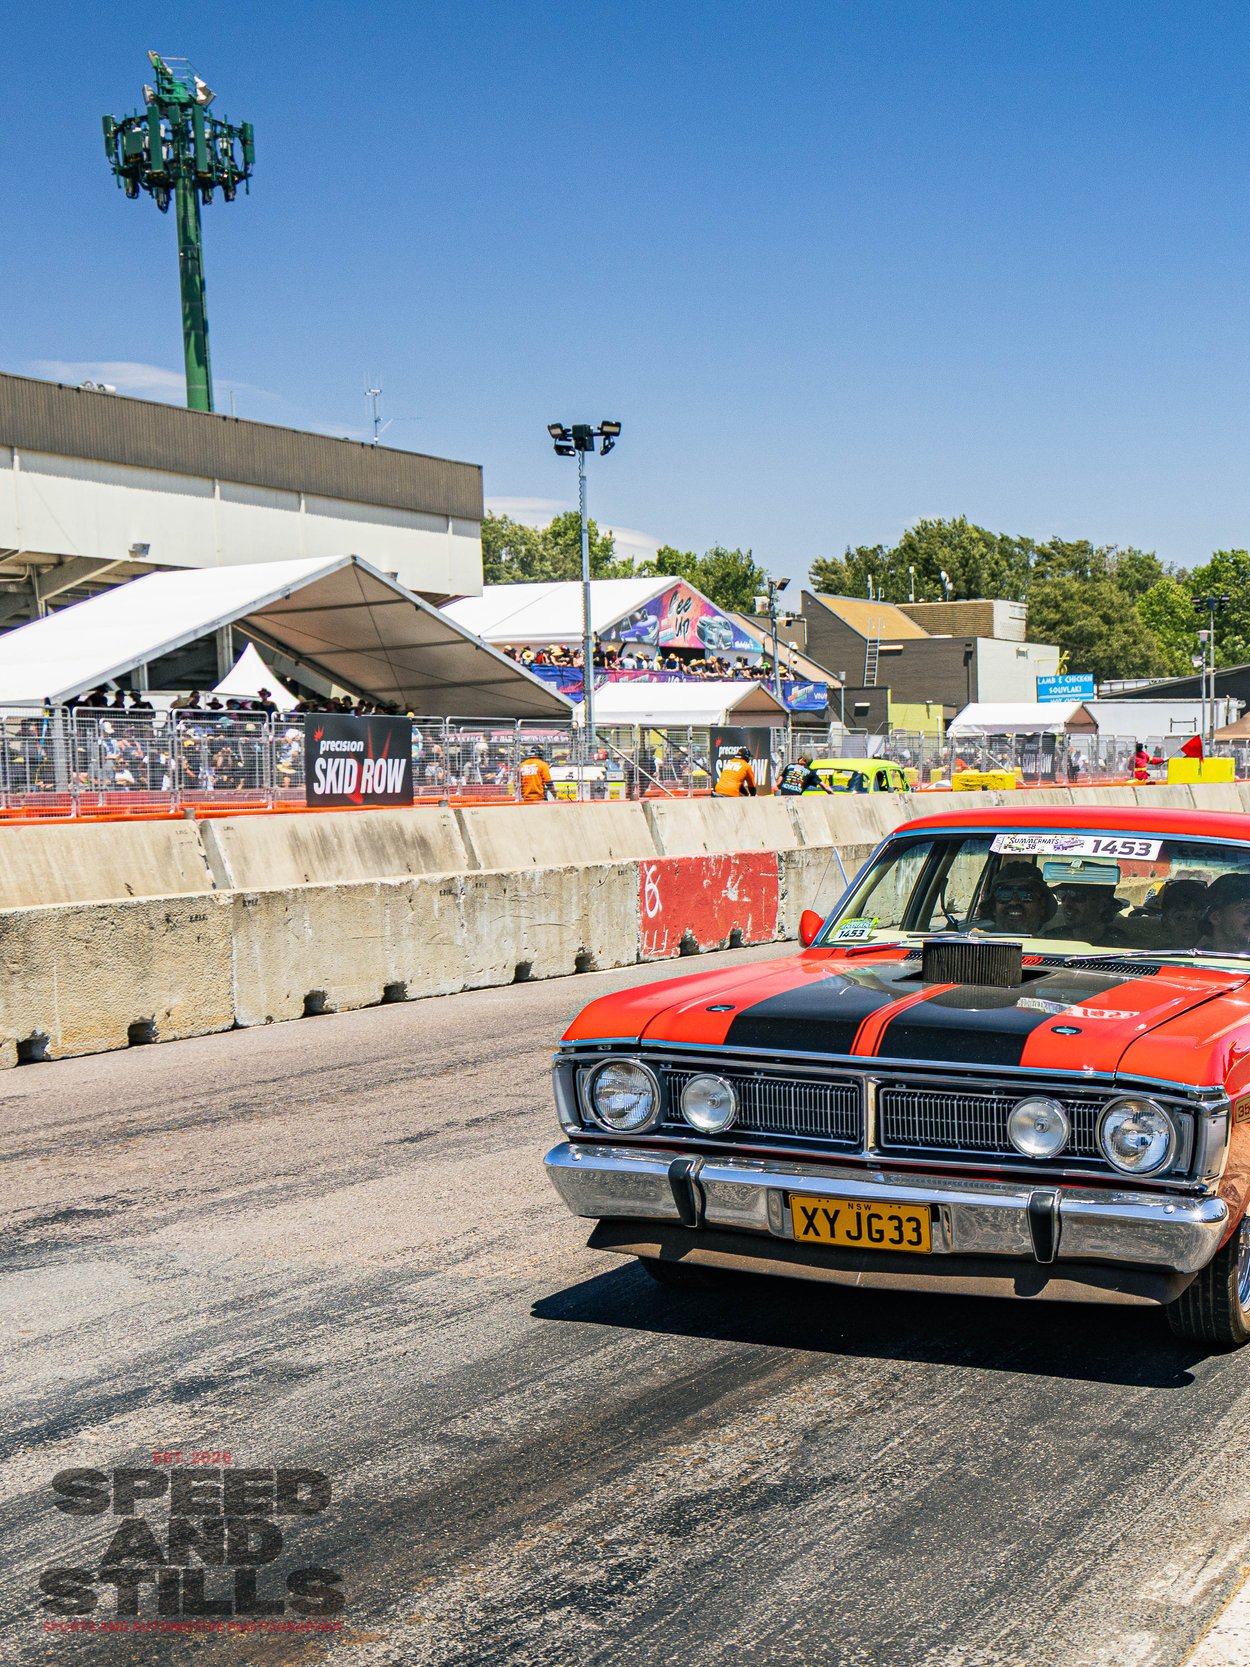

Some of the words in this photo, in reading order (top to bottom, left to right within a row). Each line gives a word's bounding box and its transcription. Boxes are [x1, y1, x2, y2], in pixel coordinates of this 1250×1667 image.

[1037, 676, 1056, 685] LAMB
[1065, 673, 1094, 683] CHICKEN
[1049, 685, 1082, 694] SOUVLAKI
[320, 740, 364, 755] precision
[313, 757, 358, 795] SKID
[360, 758, 407, 794] ROW
[1009, 836, 1060, 845] SUMMERNATS
[1092, 839, 1152, 857] 1453
[839, 929, 865, 938] 1453
[847, 1202, 872, 1211] NSW
